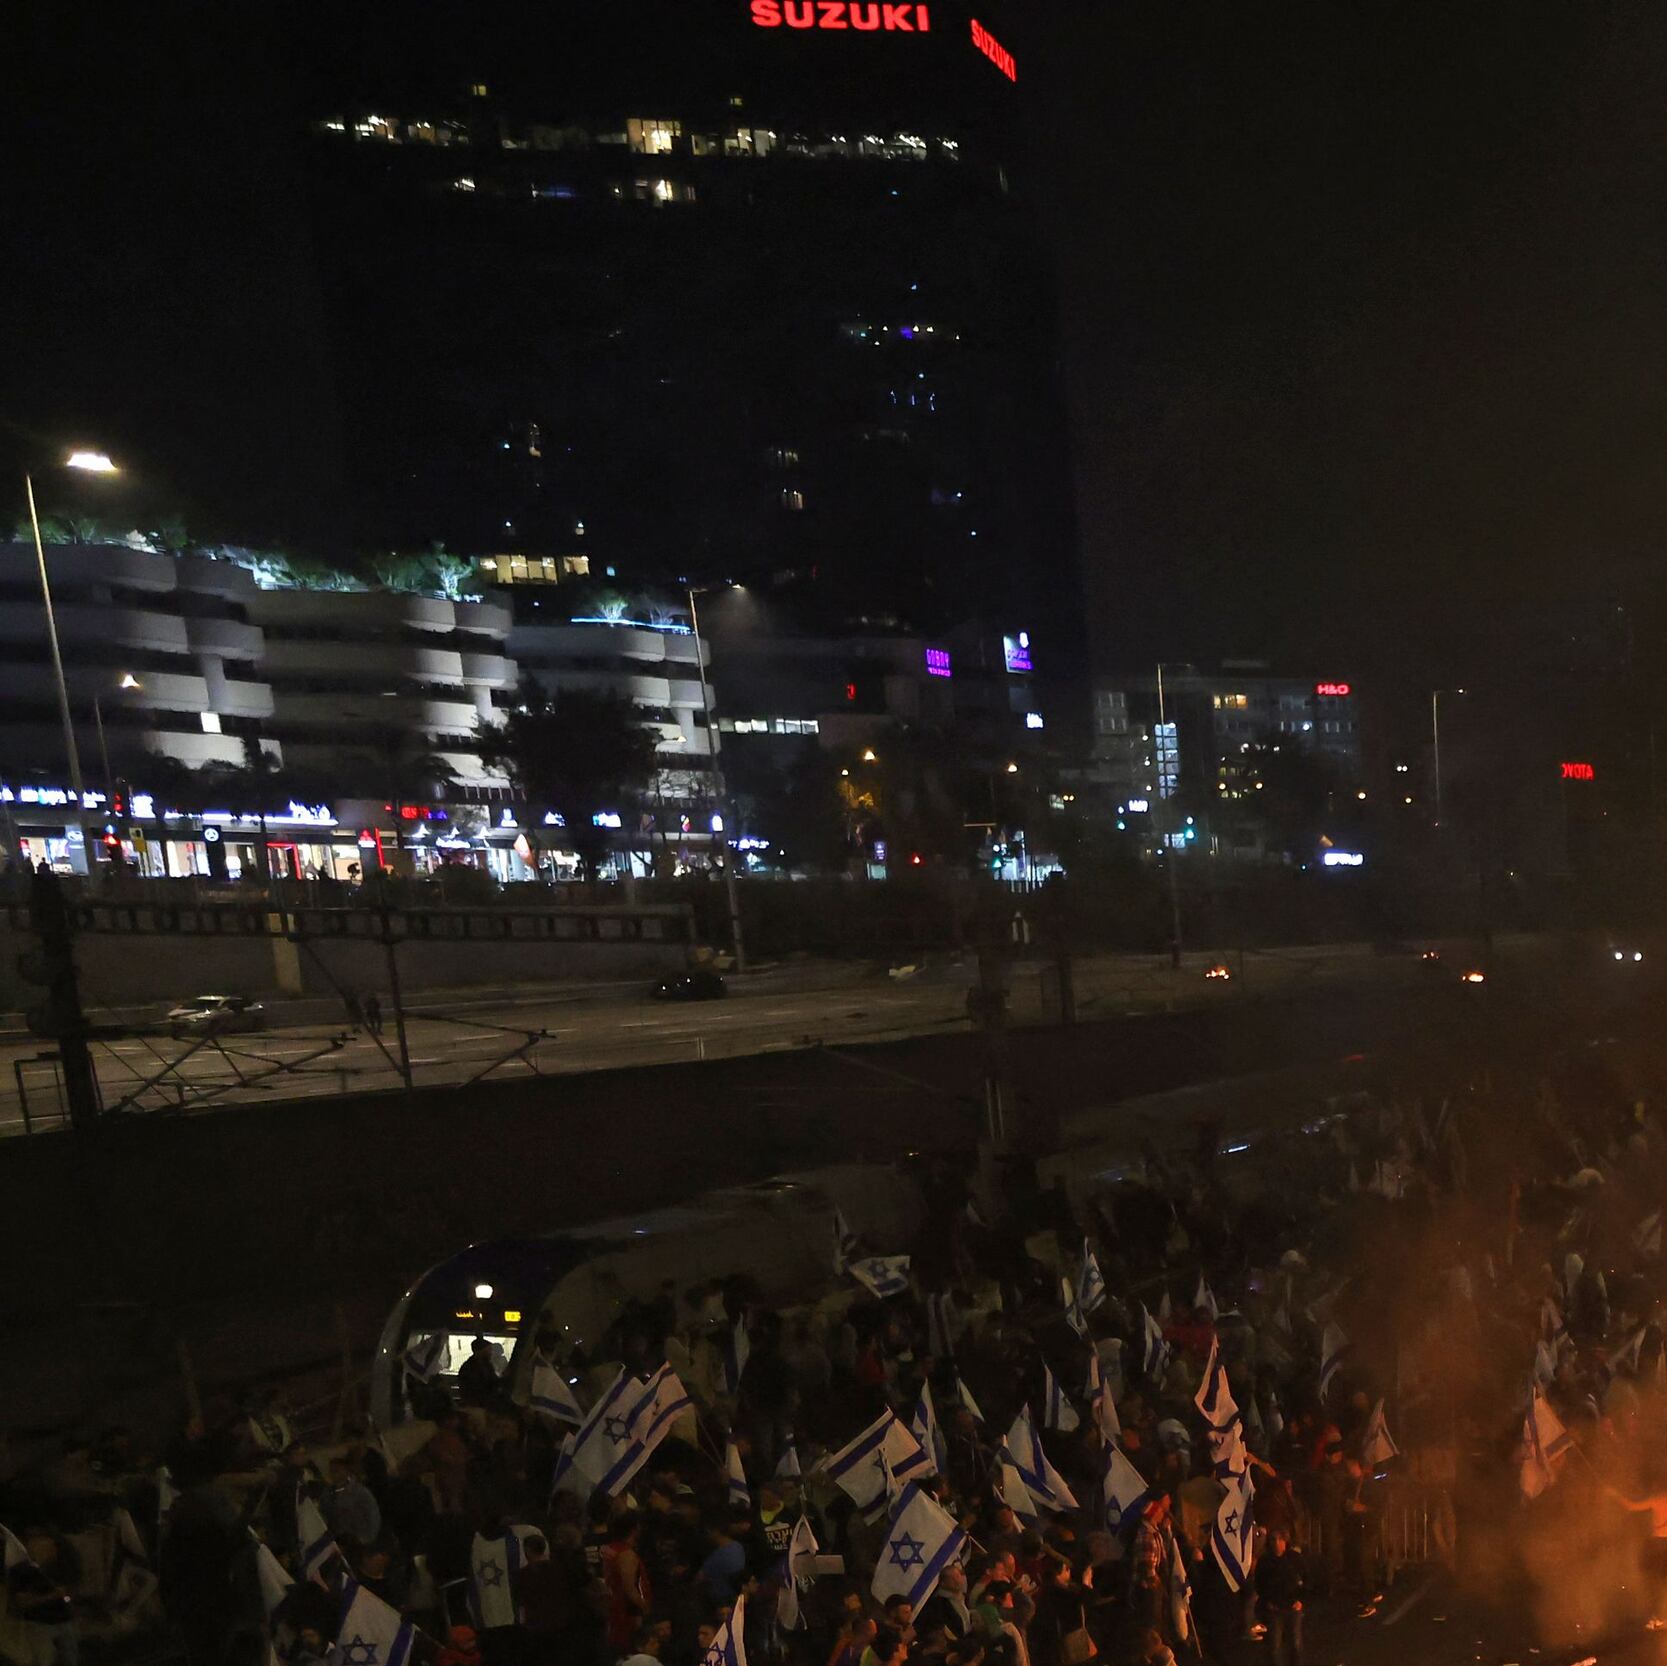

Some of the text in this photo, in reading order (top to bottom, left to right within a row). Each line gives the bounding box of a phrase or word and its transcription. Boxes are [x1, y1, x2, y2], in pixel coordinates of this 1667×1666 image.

[751, 0, 930, 31] SUZUKI
[970, 19, 1017, 82] SUZUKI
[1318, 684, 1349, 695] H&O
[1562, 763, 1594, 780] OYOTA
